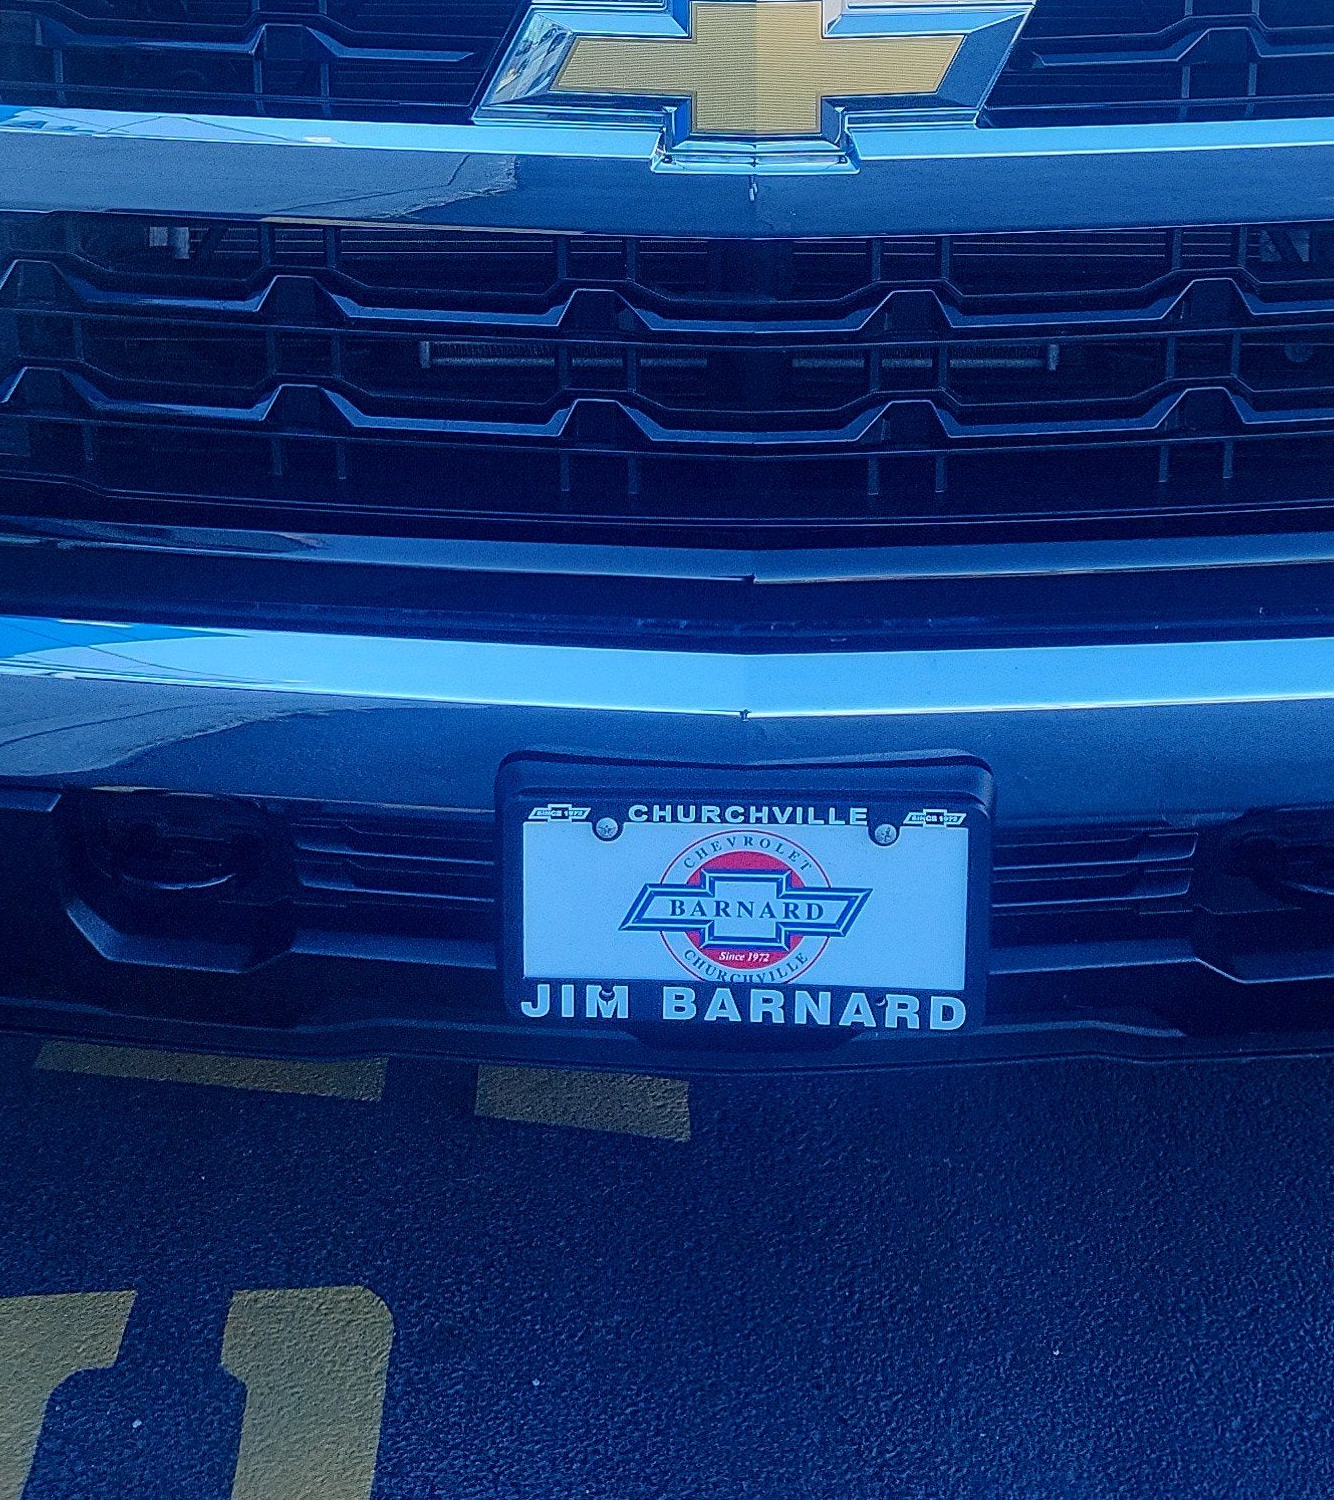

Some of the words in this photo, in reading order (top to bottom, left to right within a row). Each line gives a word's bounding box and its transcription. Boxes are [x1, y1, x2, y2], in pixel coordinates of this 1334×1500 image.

[629, 805, 867, 824] CHURCHVILLE
[683, 835, 812, 871] CHEVROLET
[671, 900, 824, 920] BARNARD
[684, 949, 809, 983] CHURCHVILLE
[719, 951, 746, 962] Since
[747, 951, 770, 962] 1972
[521, 984, 629, 1019] JIM
[663, 986, 967, 1031] BARNARD
